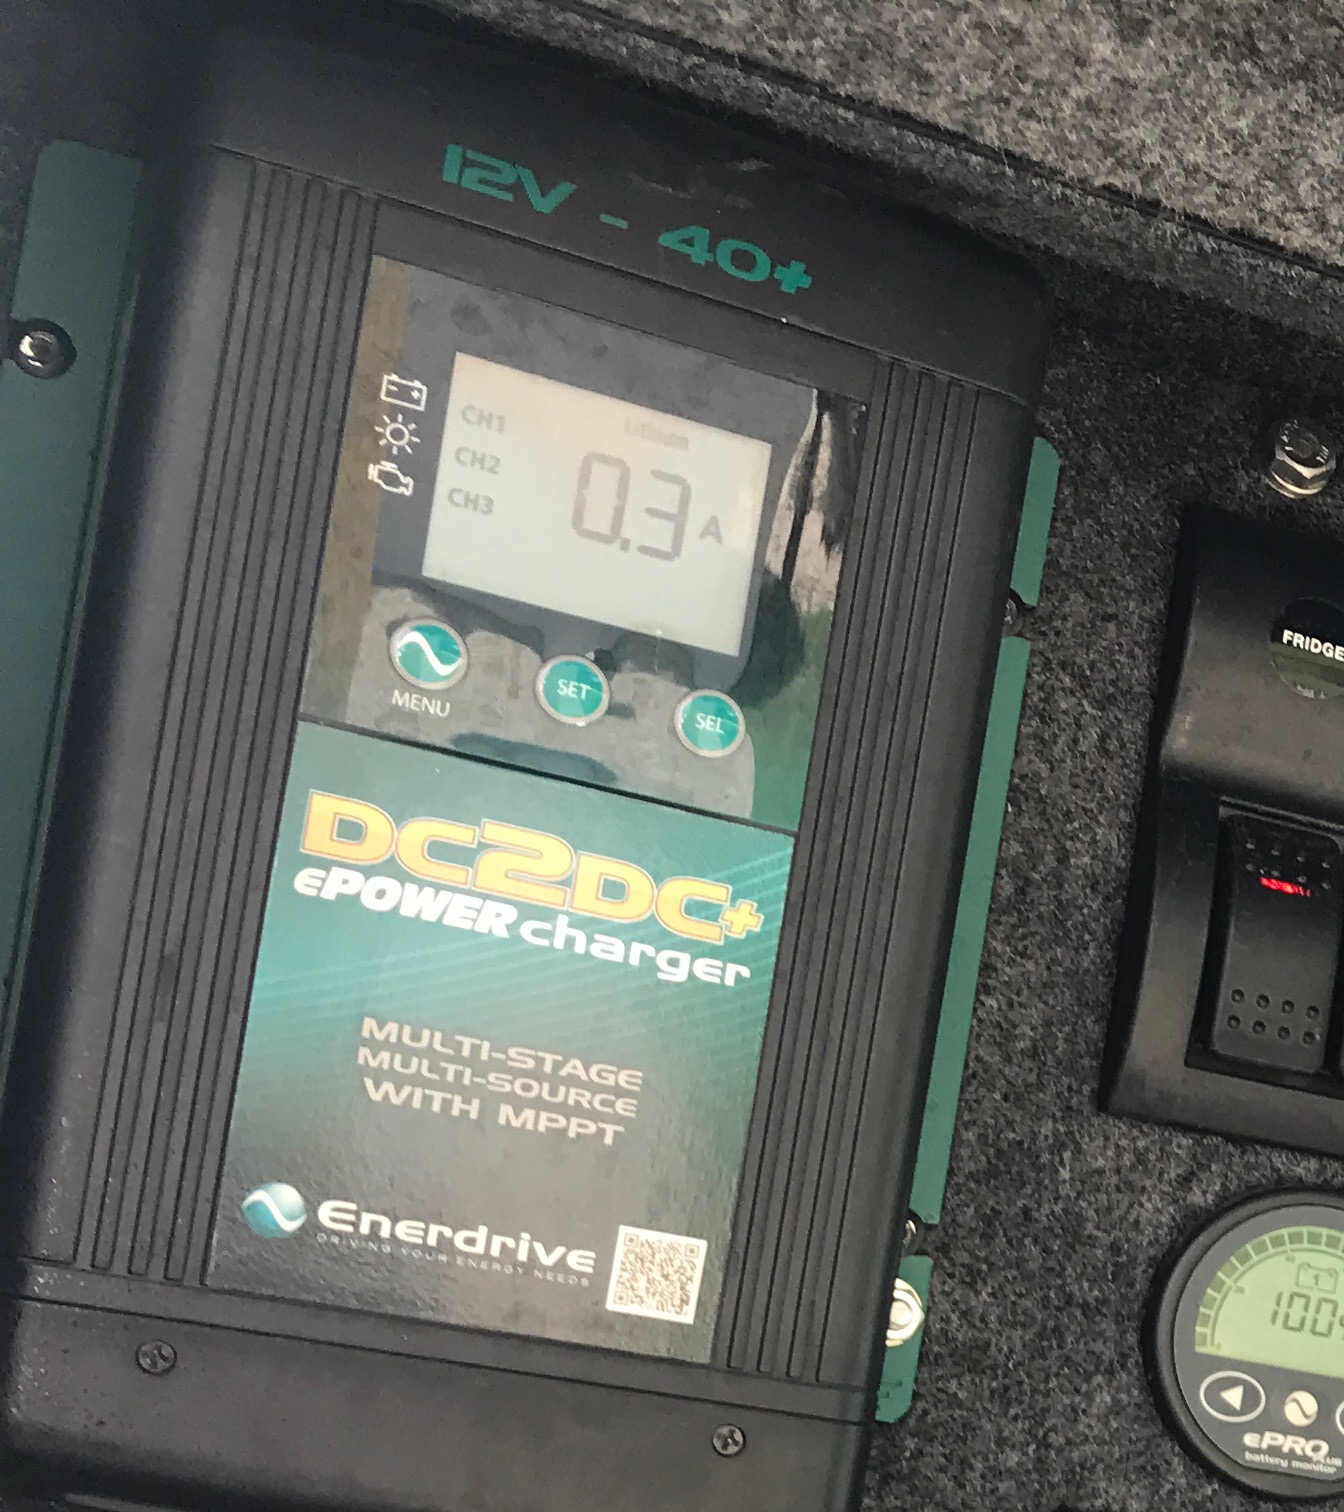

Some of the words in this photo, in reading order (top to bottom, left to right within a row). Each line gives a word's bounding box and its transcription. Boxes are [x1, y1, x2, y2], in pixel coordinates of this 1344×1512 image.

[442, 143, 578, 214] 12V
[657, 224, 812, 295] 40+
[460, 403, 506, 435] CH1
[454, 446, 501, 476] CH2
[447, 487, 495, 516] CH3
[571, 450, 692, 562] 0.3
[699, 514, 724, 545] A
[391, 689, 451, 718] MENU
[556, 678, 592, 700] SET
[694, 712, 725, 734] SEL
[299, 788, 765, 946] DC2DC+
[518, 913, 752, 988] charger
[360, 1015, 643, 1093] MULTI-STAGE
[356, 1045, 639, 1119] MULTI-SOURCE
[363, 1076, 480, 1121] WITH
[497, 1102, 626, 1147] MPPT
[317, 1199, 597, 1274] Enerdrive
[455, 1255, 526, 1276] ENERGY
[532, 1268, 590, 1288] NEEDS
[1244, 1450, 1289, 1468] battery
[1291, 1459, 1338, 1475] monitor
